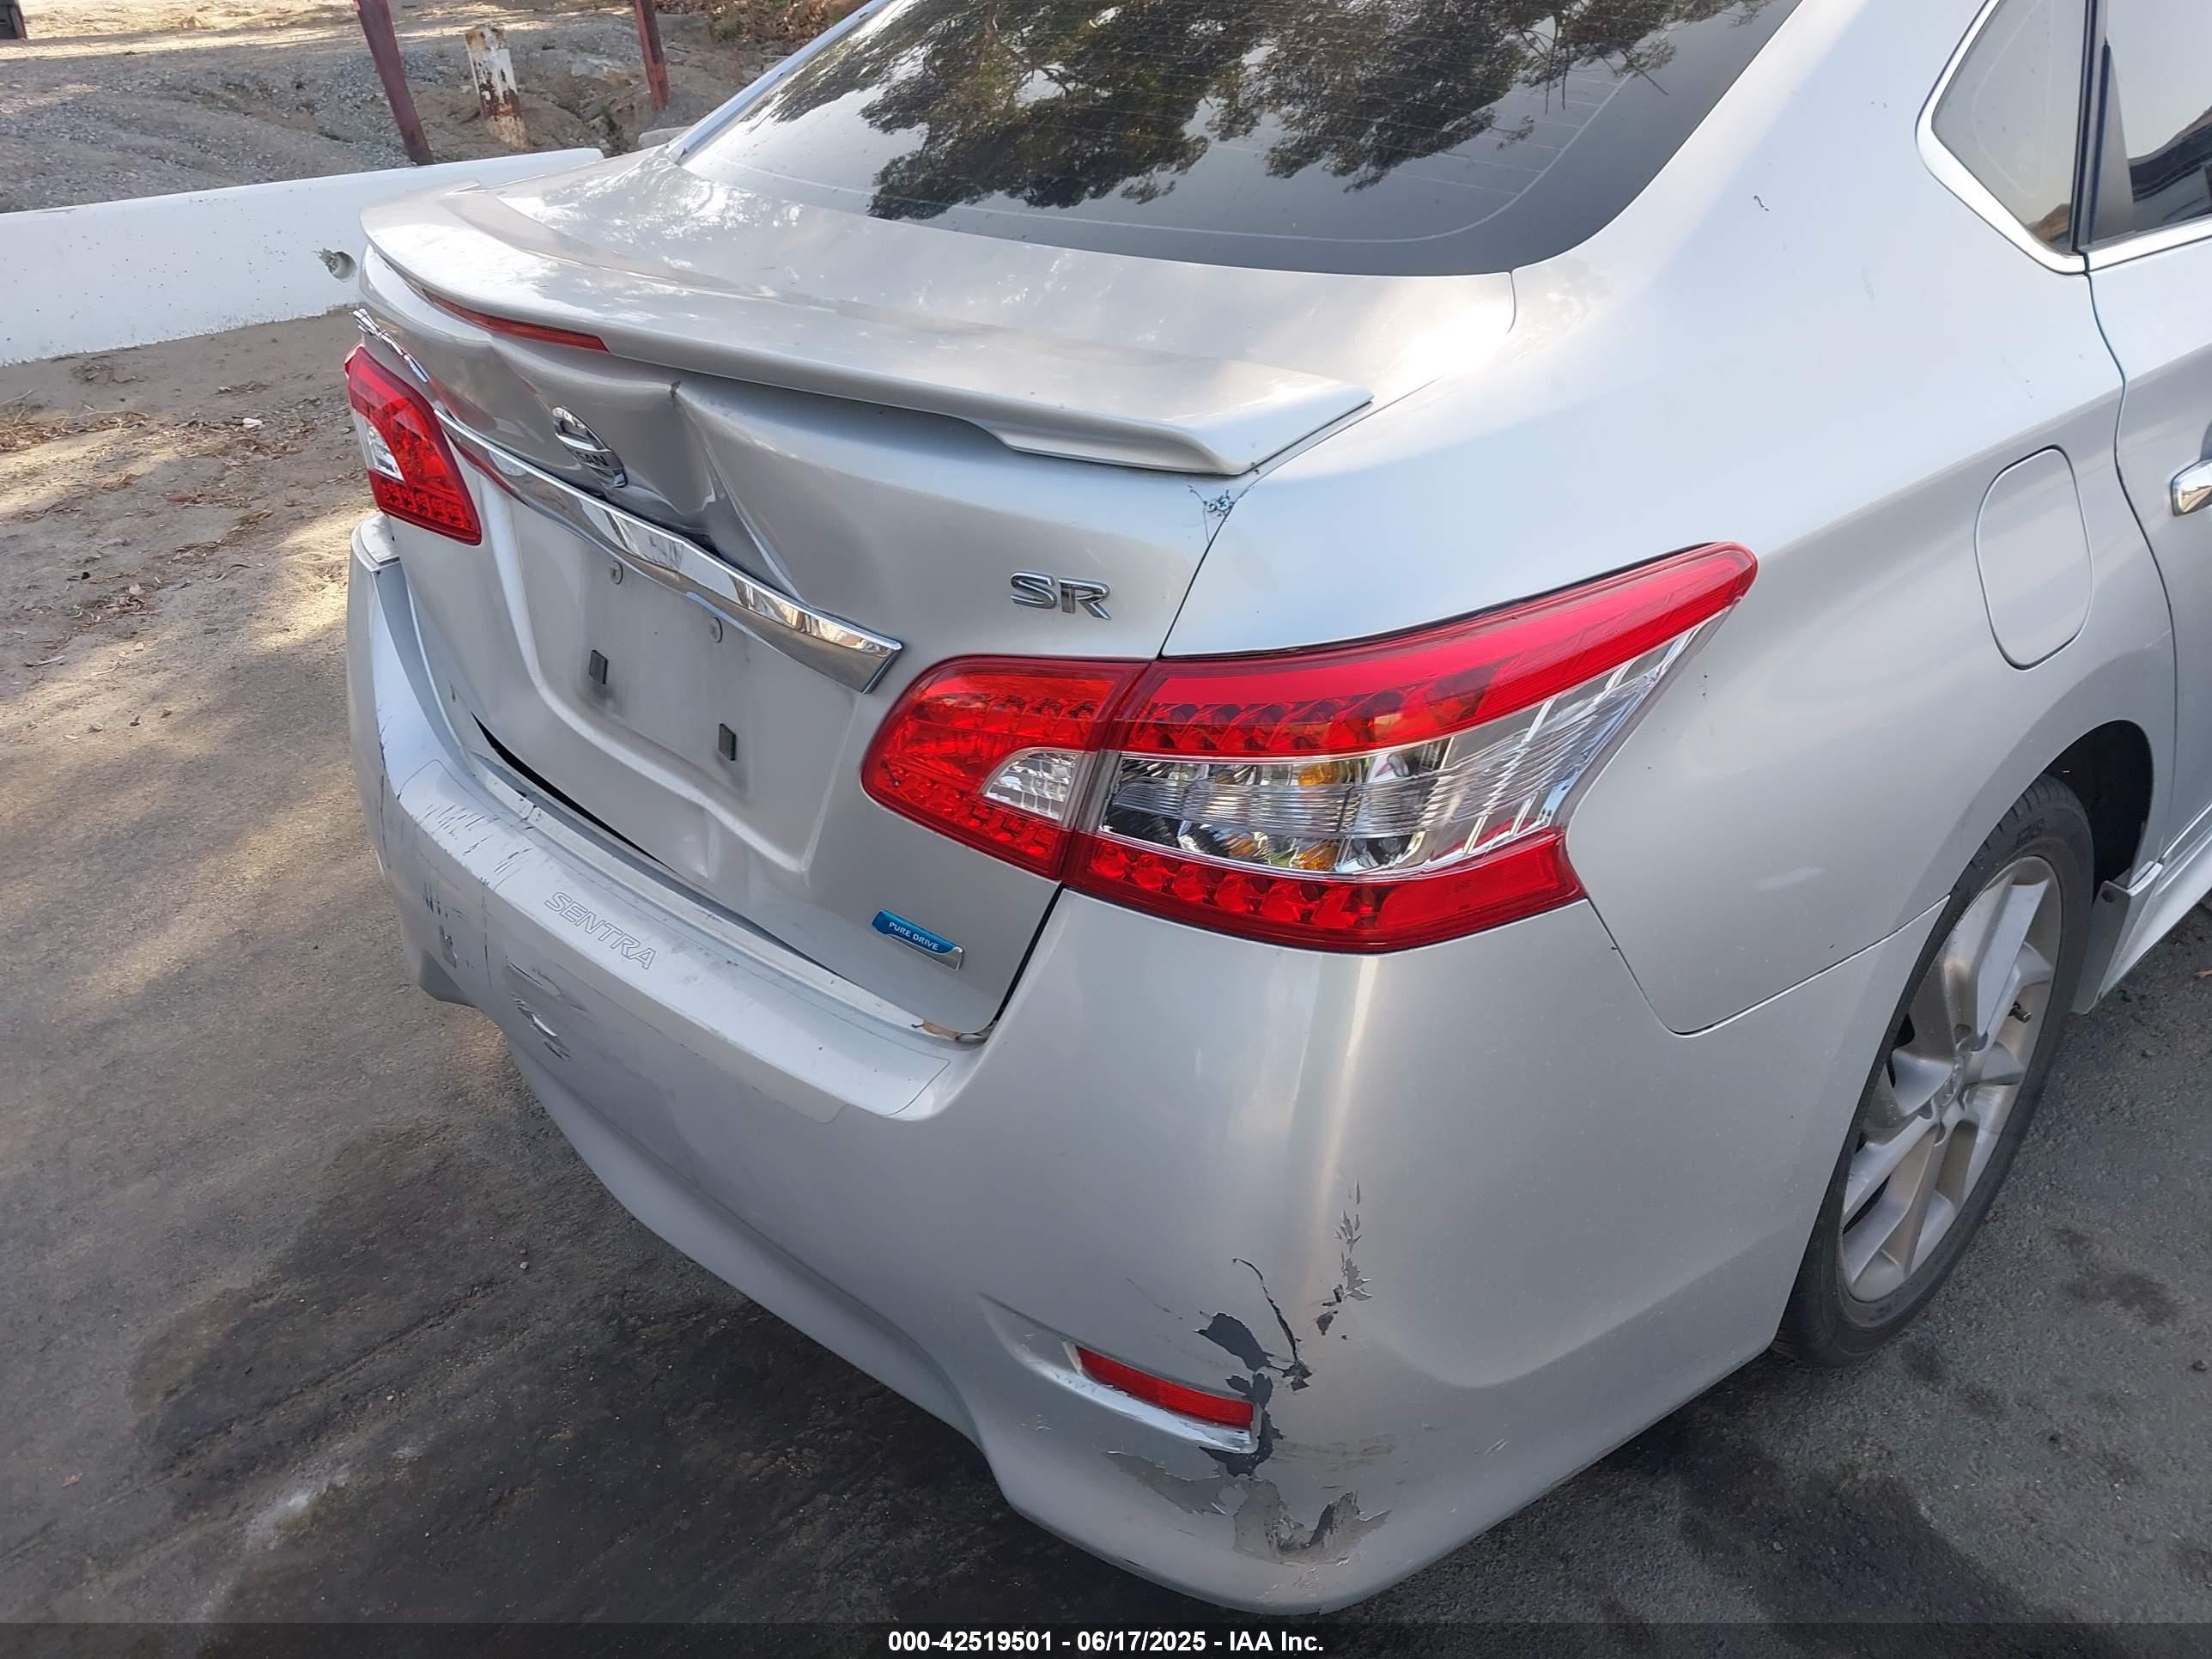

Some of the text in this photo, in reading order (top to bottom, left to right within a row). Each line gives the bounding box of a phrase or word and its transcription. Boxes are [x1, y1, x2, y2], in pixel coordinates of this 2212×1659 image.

[1010, 570, 1112, 620] SR
[544, 892, 657, 970] SENTRA
[889, 921, 939, 951] PURE DRIVE
